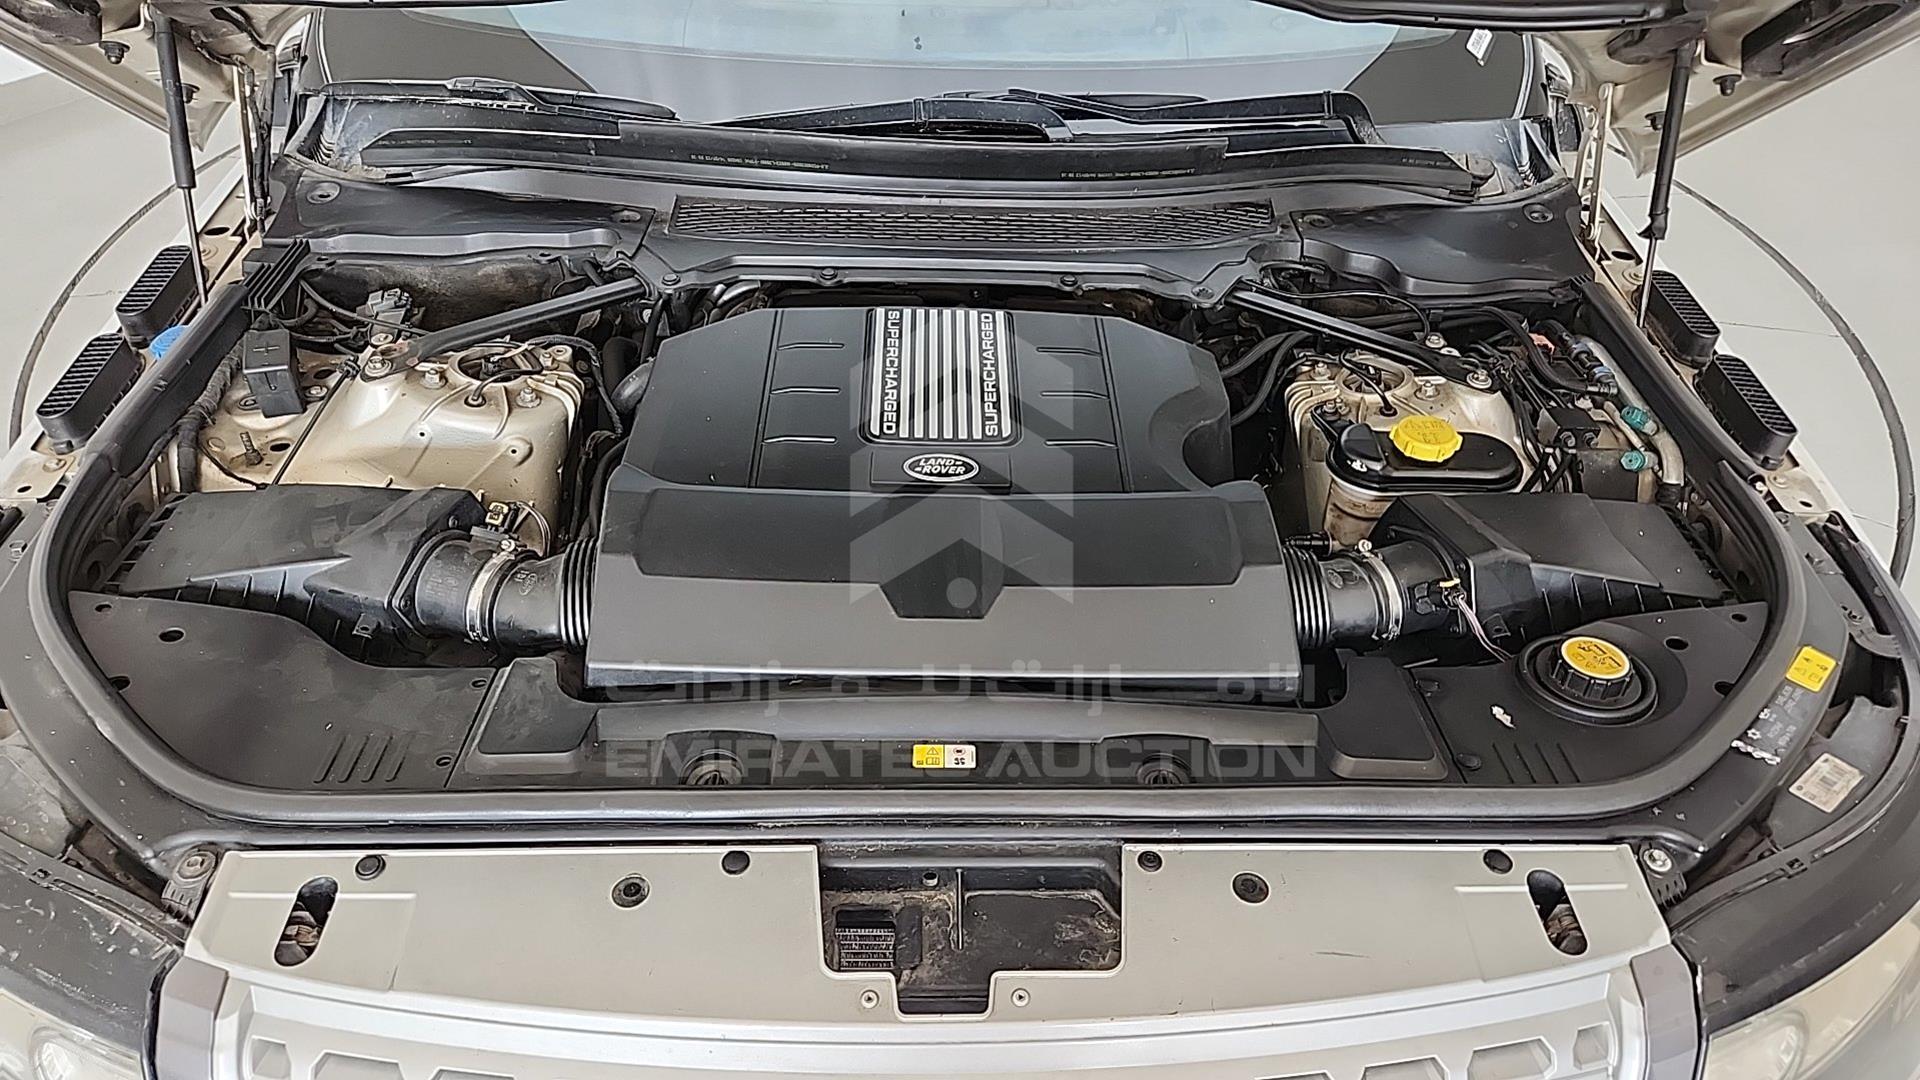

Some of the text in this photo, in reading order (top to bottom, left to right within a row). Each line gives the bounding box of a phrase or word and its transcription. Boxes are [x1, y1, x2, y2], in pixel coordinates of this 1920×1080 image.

[883, 310, 900, 435] SUPERCHARGED
[981, 312, 998, 436] SUPERCHARGED
[919, 458, 955, 466] LAND
[921, 466, 966, 474] ROVER
